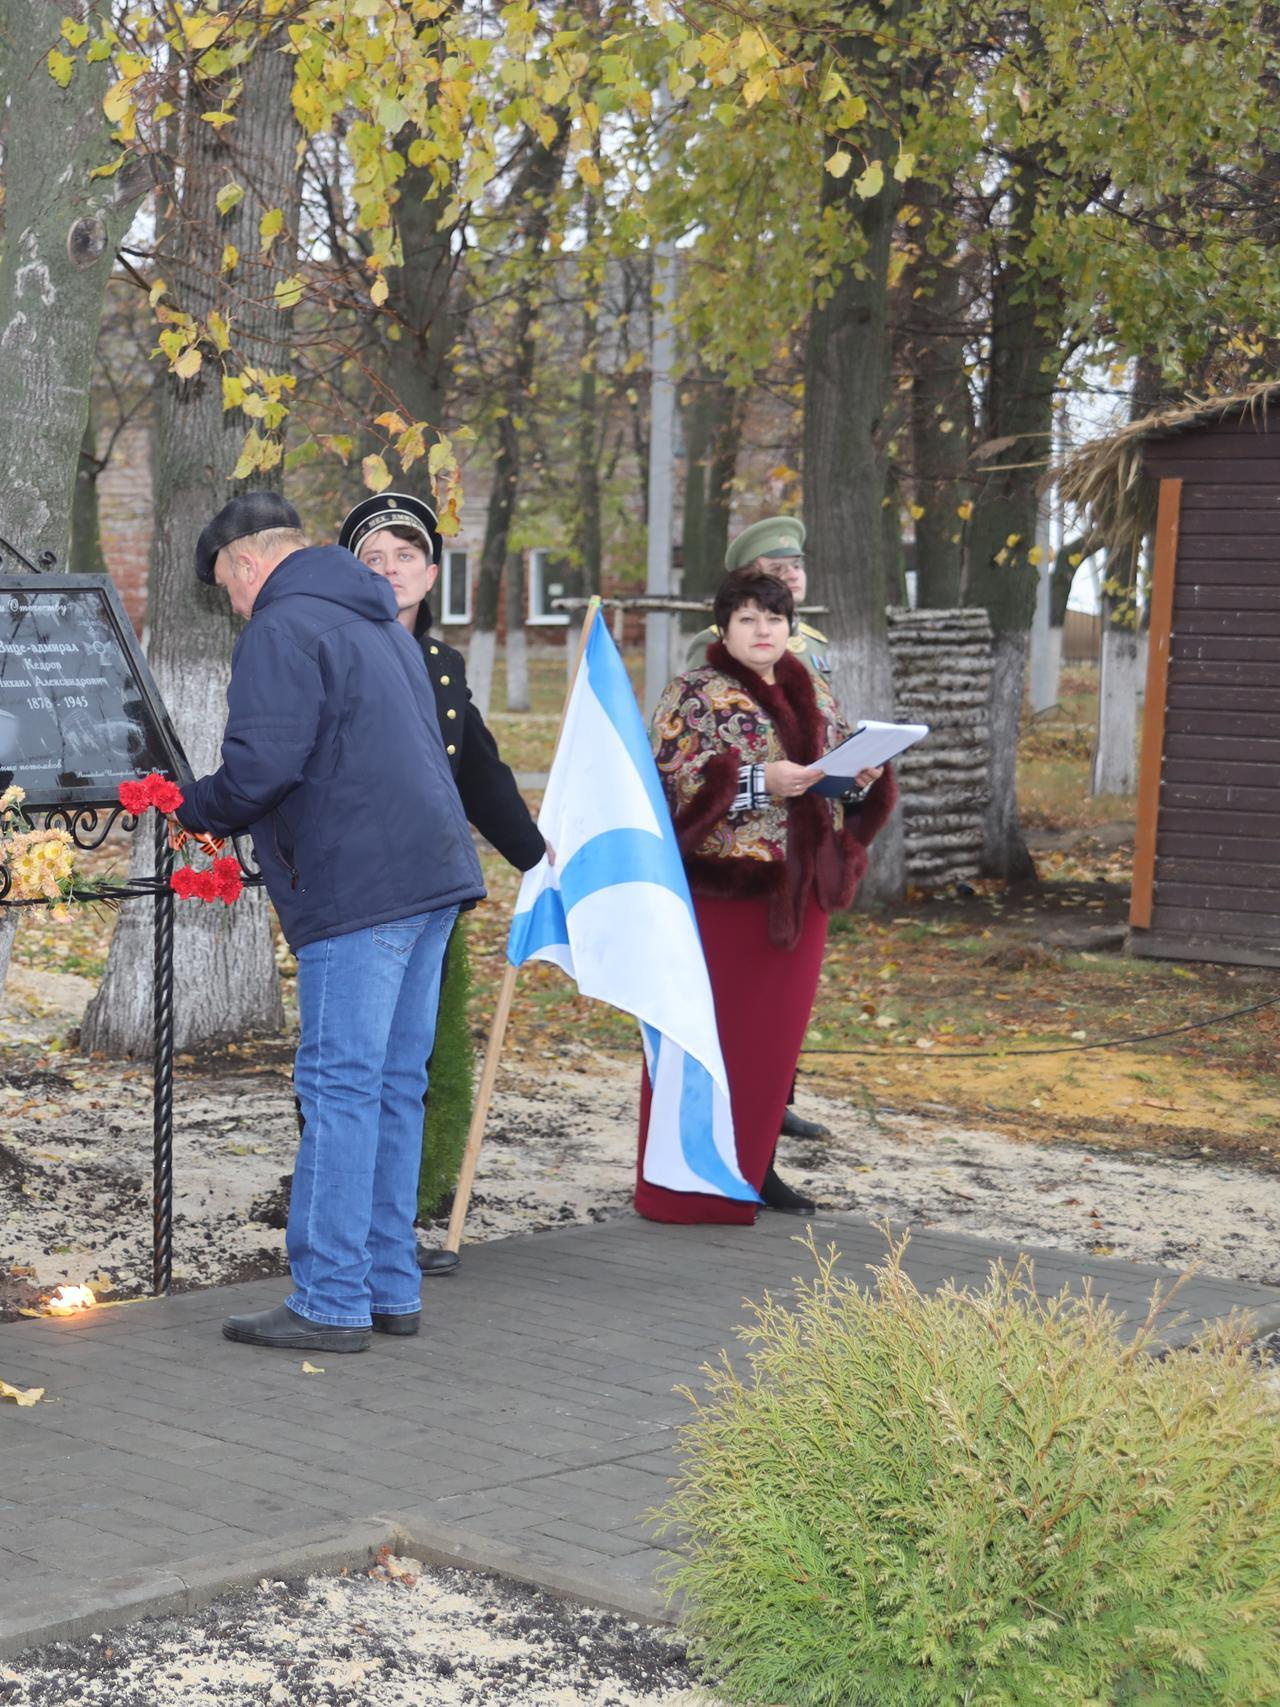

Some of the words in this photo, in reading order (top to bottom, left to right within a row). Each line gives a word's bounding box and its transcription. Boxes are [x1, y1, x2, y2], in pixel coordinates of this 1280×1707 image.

[23, 658, 62, 672] Кедров
[34, 675, 109, 688] Александрович
[26, 697, 53, 710] 1878
[63, 695, 89, 708] 1945
[19, 758, 63, 771] потомков
